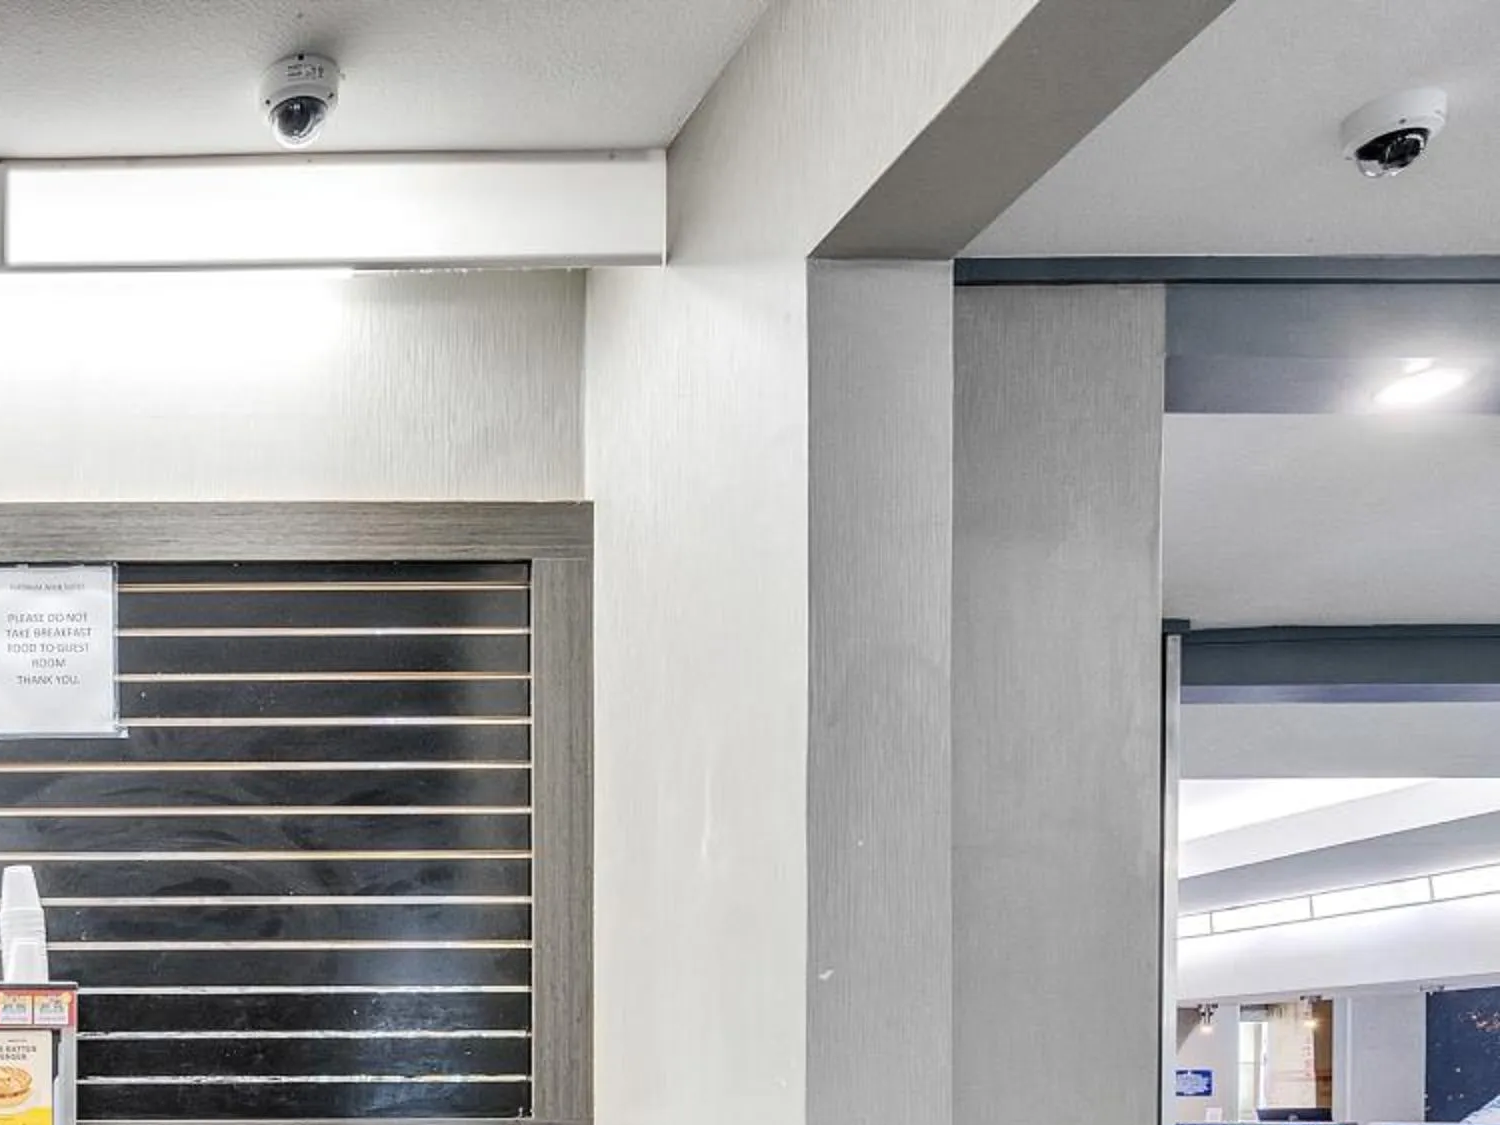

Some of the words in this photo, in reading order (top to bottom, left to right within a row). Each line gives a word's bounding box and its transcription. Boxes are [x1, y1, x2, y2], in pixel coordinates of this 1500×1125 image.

[6, 612, 44, 623] PLEASE
[47, 612, 65, 623] DO
[66, 611, 88, 623] NOT
[6, 626, 30, 638] TAKE
[33, 626, 92, 638] BREAKFAST
[6, 642, 37, 653] FOOD
[39, 642, 56, 653] TO
[57, 642, 89, 653] GUEST
[31, 657, 66, 669] ROOM
[16, 674, 53, 685] THANK
